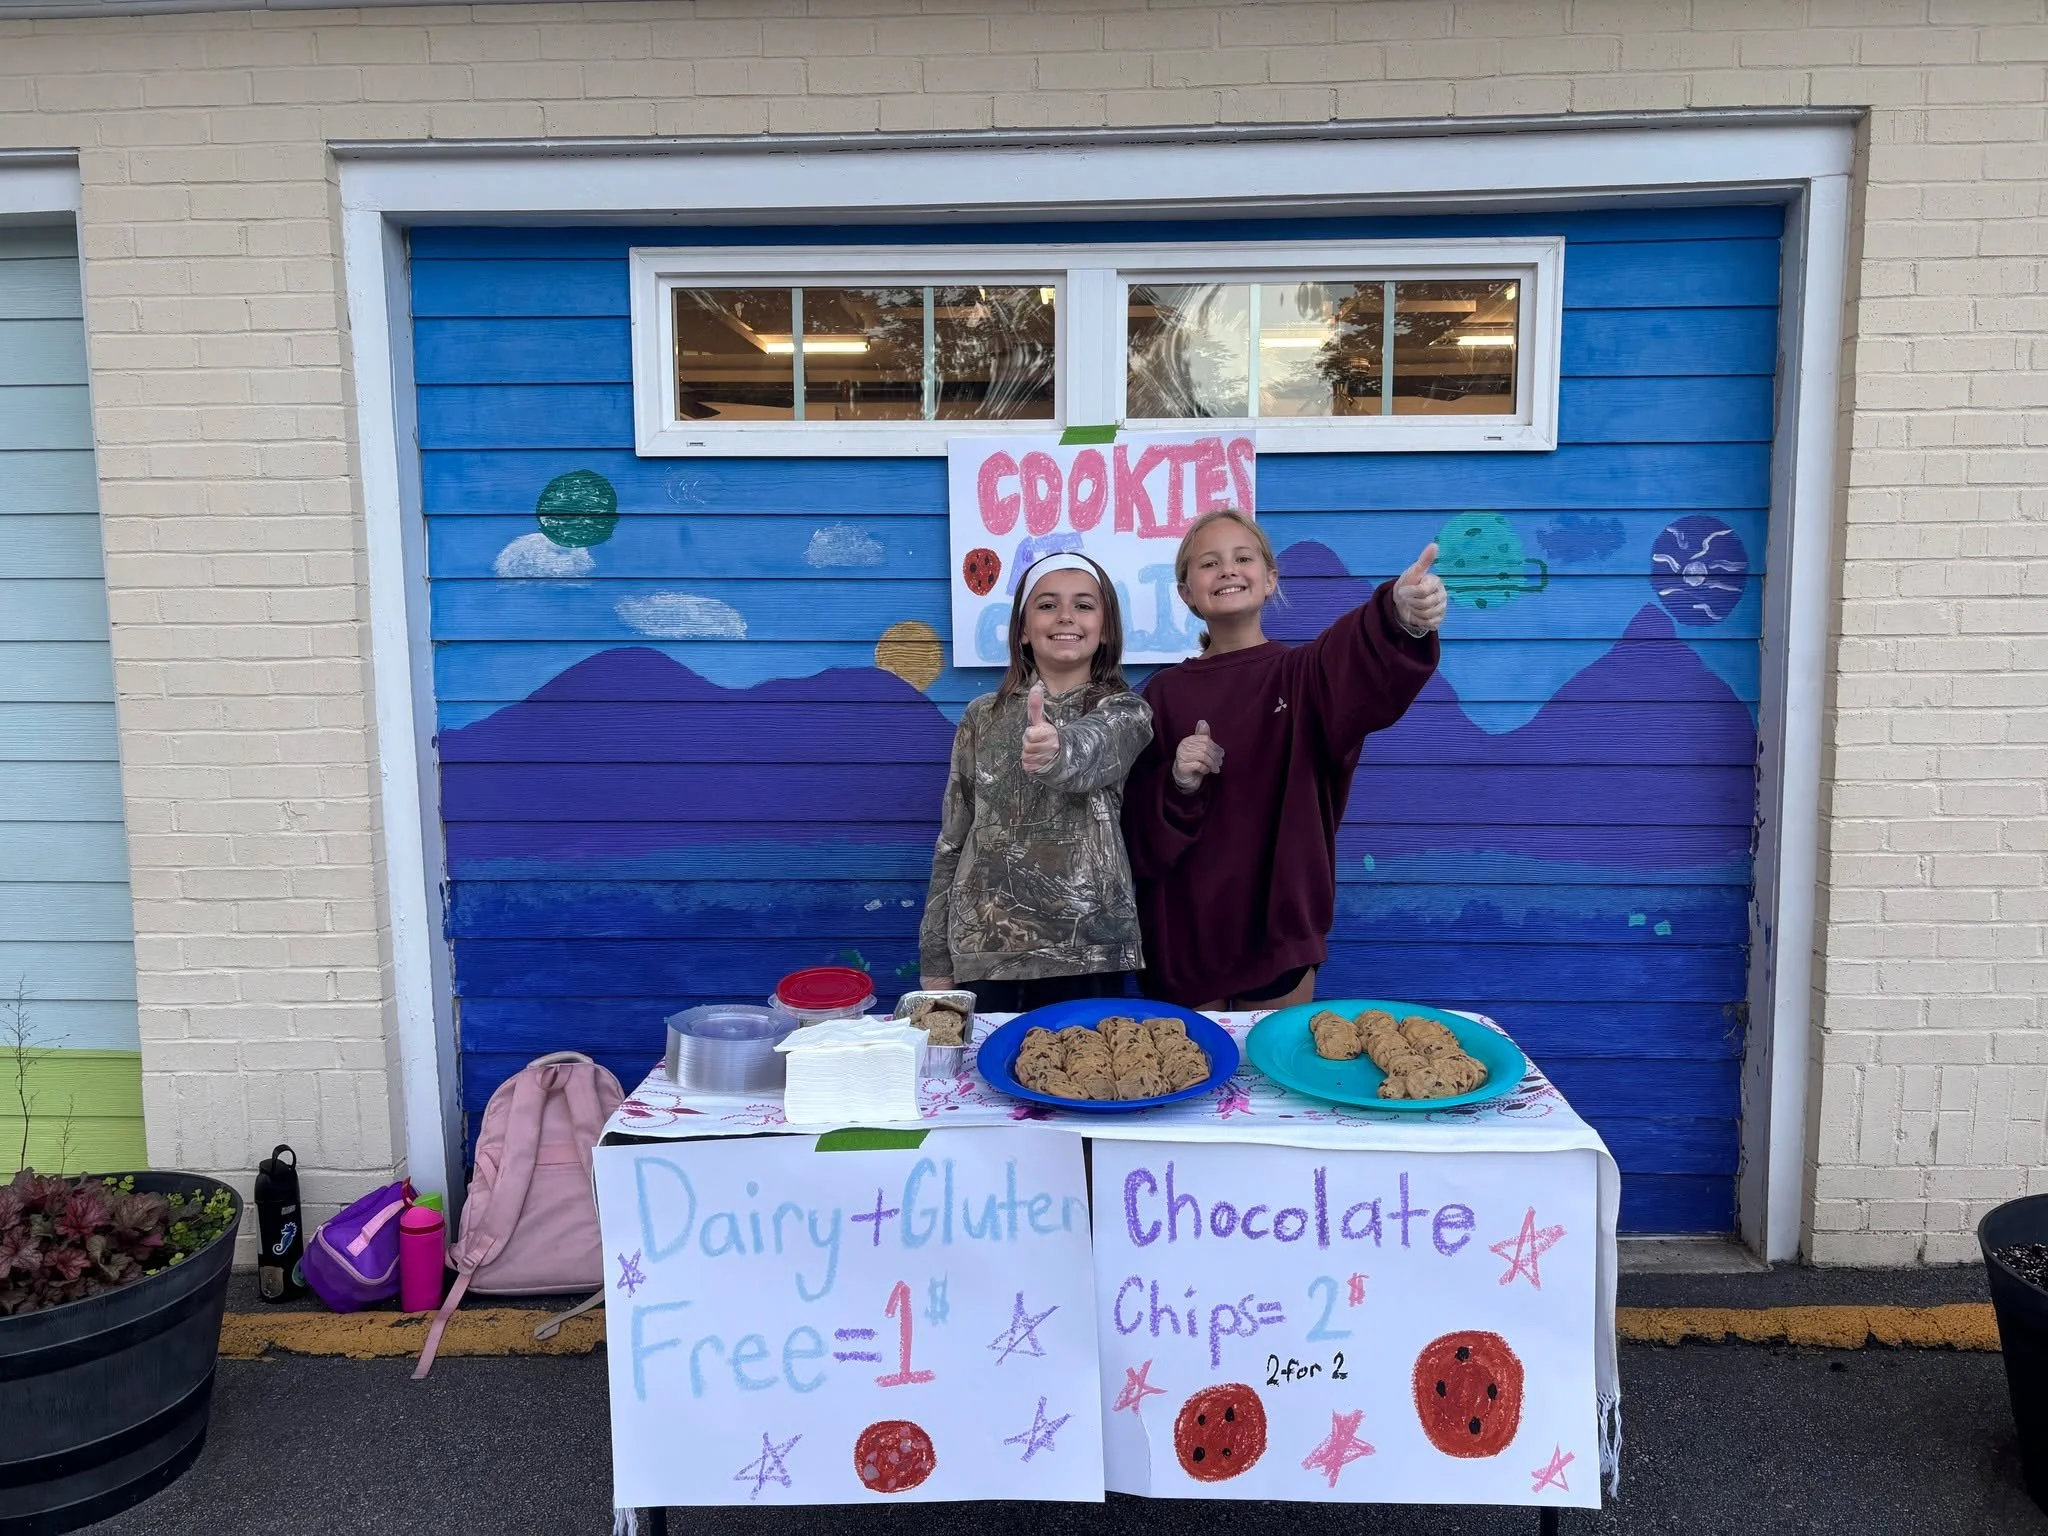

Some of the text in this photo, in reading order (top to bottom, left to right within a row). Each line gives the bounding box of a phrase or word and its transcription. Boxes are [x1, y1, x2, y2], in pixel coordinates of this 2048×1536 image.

[977, 437, 1255, 538] COOKIES
[632, 1156, 842, 1301] Dairy
[1123, 1161, 1476, 1257] Chocolate
[1281, 1358, 1322, 1383] for
[1332, 1351, 1348, 1380] 2
